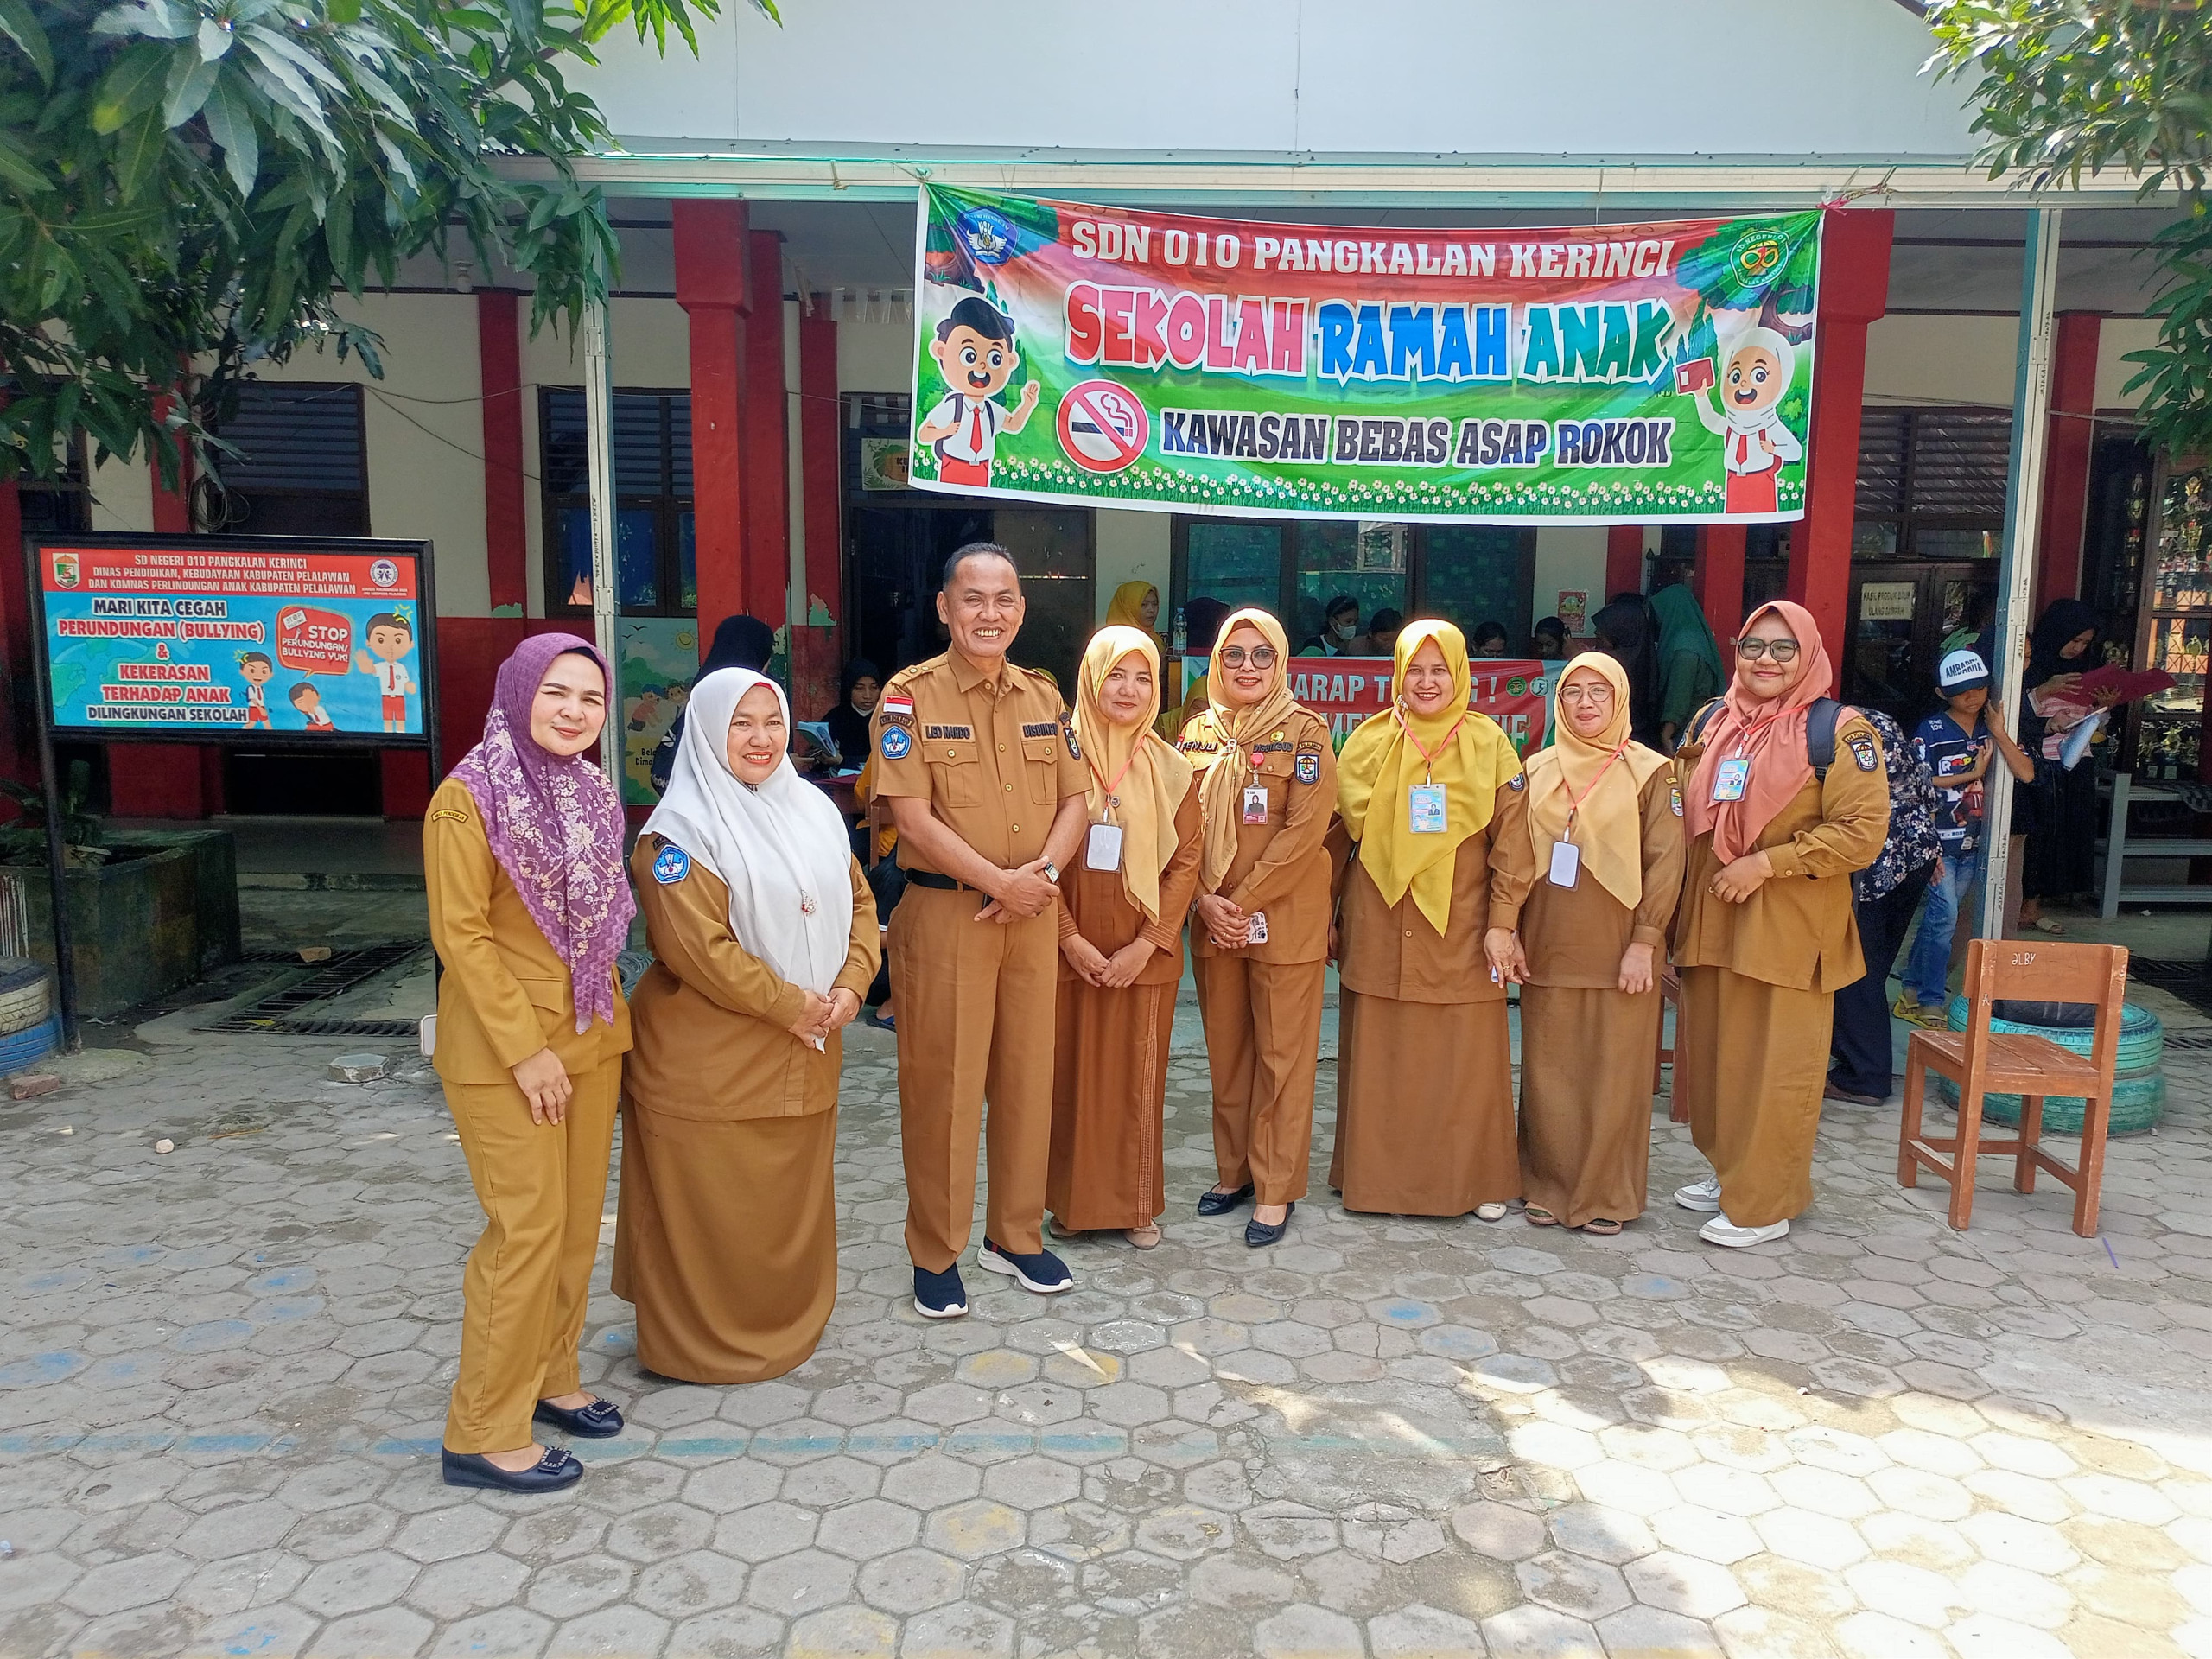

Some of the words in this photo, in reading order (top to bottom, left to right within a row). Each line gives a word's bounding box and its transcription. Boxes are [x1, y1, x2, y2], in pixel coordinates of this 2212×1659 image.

[1072, 221, 1152, 263] SDN
[1163, 230, 1241, 270] 010
[1254, 235, 1497, 278] PANGKALAN
[1509, 240, 1675, 277] KERINCI
[1065, 283, 1307, 375] SEKOLAH
[1318, 300, 1510, 385] RAMAH
[1520, 298, 1675, 383] ANAK
[1163, 410, 1328, 462] KAWASAN
[1335, 418, 1450, 465] BEBAS
[1457, 420, 1548, 467] ASAP
[1557, 421, 1672, 467] ROKOK
[135, 555, 148, 565] SD
[150, 555, 184, 566] NEGERI
[187, 556, 206, 566] 010
[208, 556, 266, 569] PANGKALAN
[269, 557, 307, 569] KERINCI
[93, 567, 121, 577] DINAS
[124, 567, 181, 580] PENDIDIKAN,
[182, 569, 240, 580] KEBUDAYAAN
[243, 570, 294, 582] KABUPATEN
[297, 571, 350, 582] PELALAWAN
[88, 578, 107, 588] DAN
[110, 579, 149, 589] KOMNAS
[151, 580, 219, 591] PERLINDUNGAN
[223, 582, 247, 592] ANAK
[250, 582, 300, 593] KABUPATEN
[303, 583, 356, 594] PELALAWAN
[93, 599, 133, 615] MARI
[137, 600, 172, 616] KITA
[175, 601, 226, 617] CEGAH
[59, 620, 175, 638] PERUNDUNGAN
[180, 620, 264, 642] (BULLYING)
[308, 625, 348, 641] STOP
[157, 644, 168, 658] &
[282, 638, 348, 652] PERUNDUNGAN/
[282, 647, 326, 659] BULLYING
[328, 652, 348, 662] YUK!
[119, 664, 209, 681] KEKERASAN
[102, 686, 181, 702] TERHADAP
[185, 688, 230, 702] ANAK
[88, 706, 186, 721] DILINGKUNGAN
[189, 708, 247, 721] SEKOLAH
